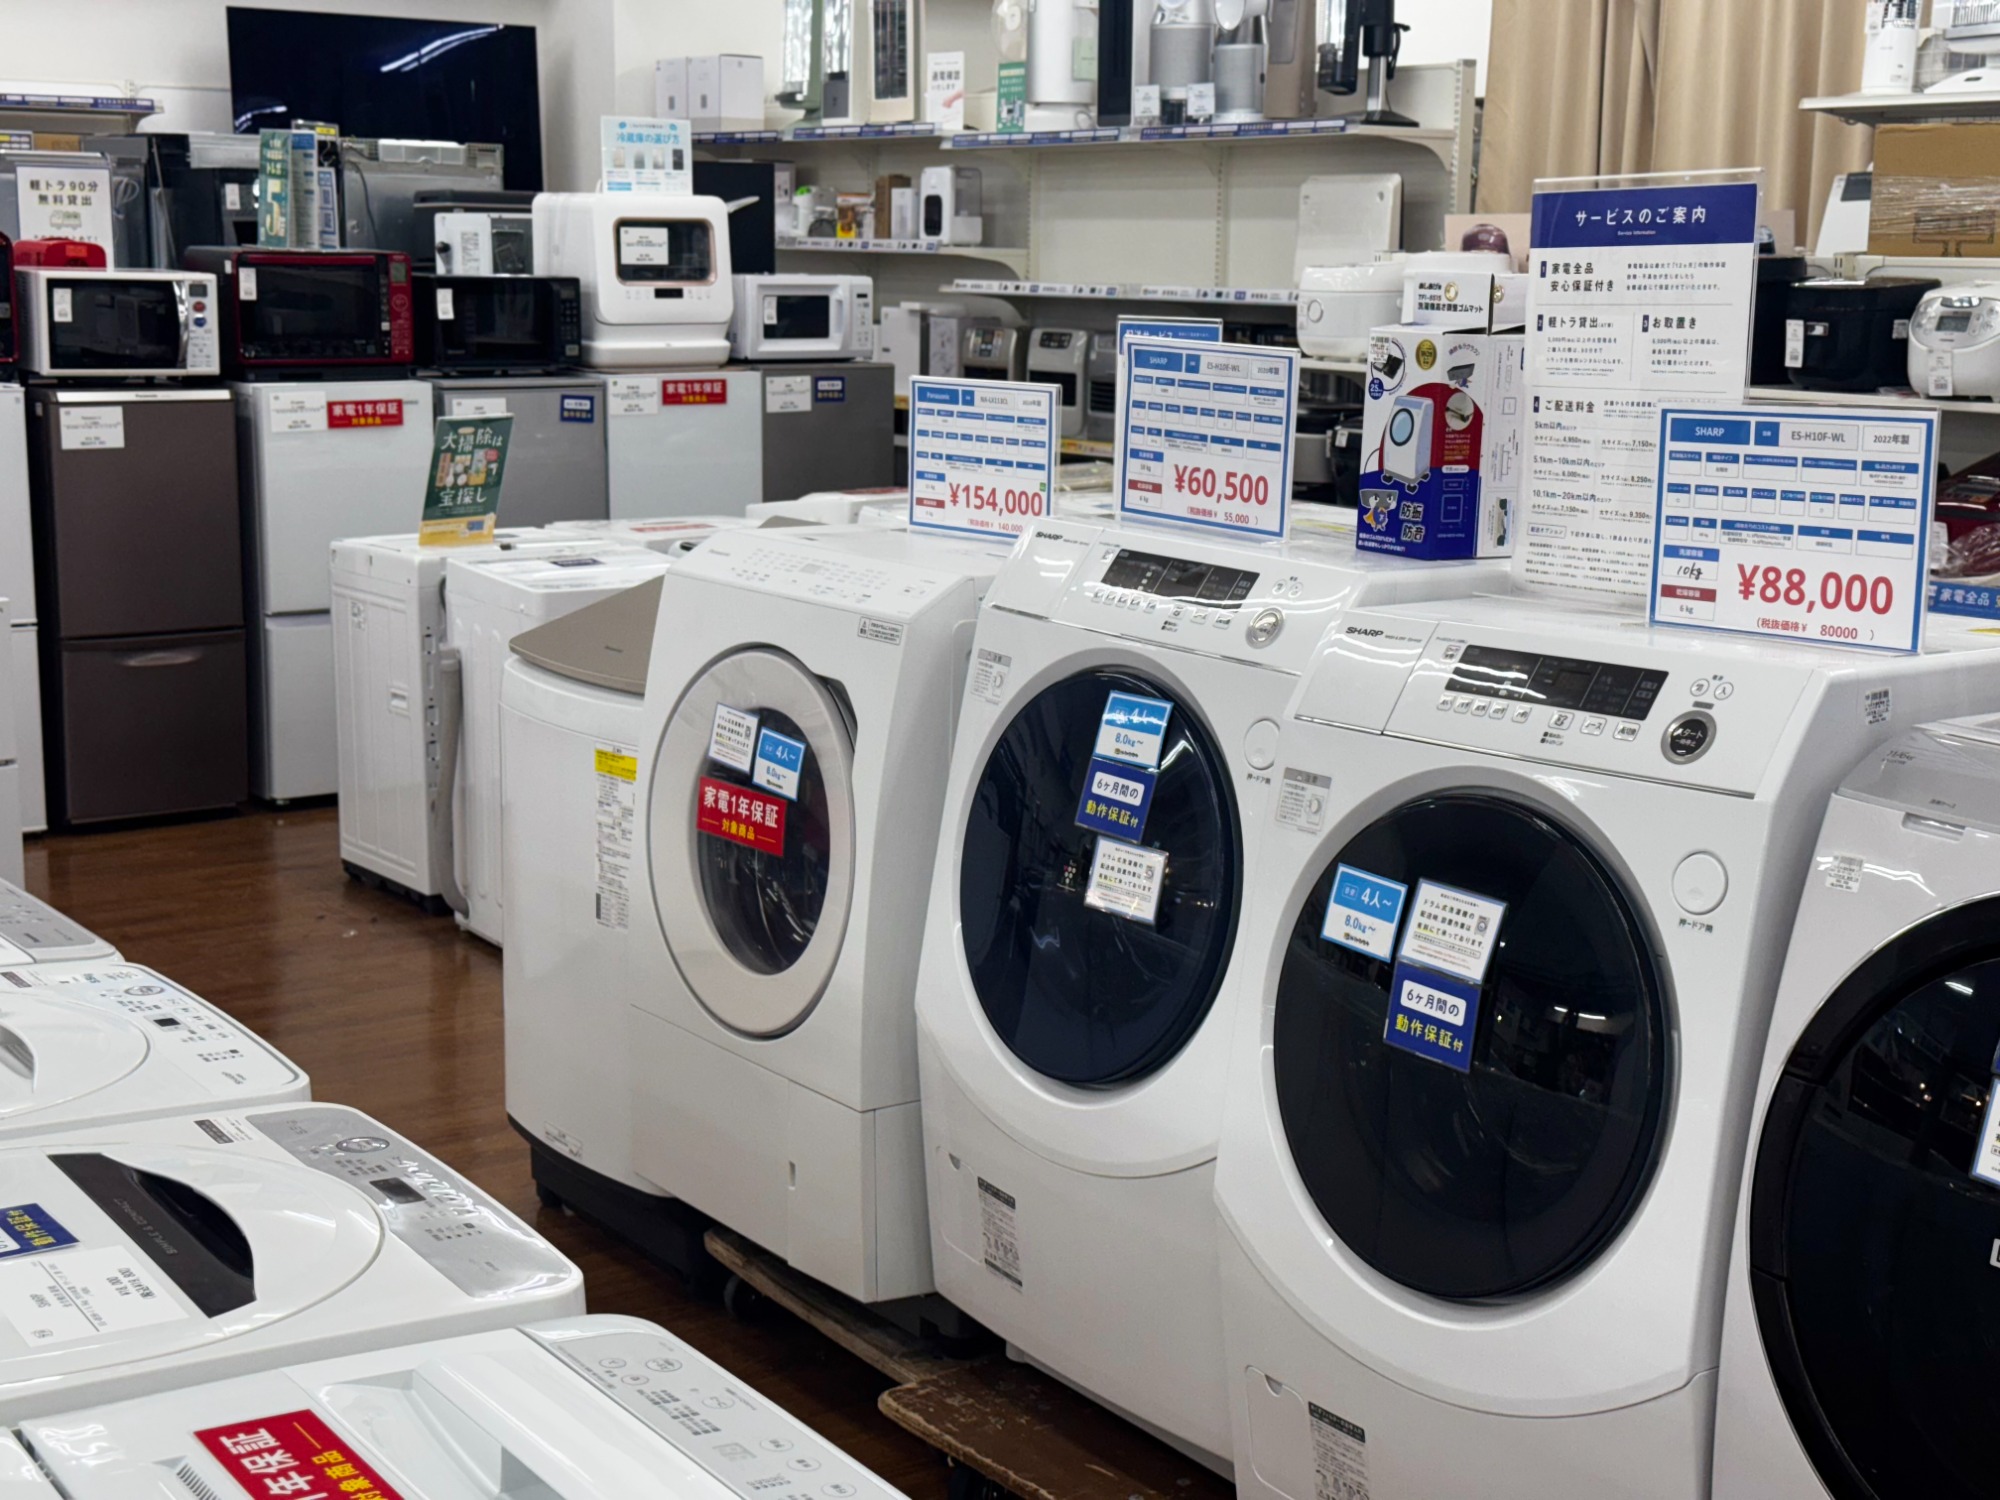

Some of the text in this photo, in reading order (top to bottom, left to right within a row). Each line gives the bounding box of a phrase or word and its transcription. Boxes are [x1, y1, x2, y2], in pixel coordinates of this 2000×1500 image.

[29, 179, 98, 192] 軽トラ90分
[38, 193, 93, 206] 無料貸出
[1575, 205, 1707, 227] サービスのご案内
[1551, 262, 1594, 275] 家電全品
[1550, 279, 1614, 292] 安心保証付き
[1548, 316, 1598, 328] 軽トラ貸出
[1652, 316, 1696, 329] お取置き
[1149, 356, 1168, 366] SHARP
[665, 381, 723, 395] 家電1年保証
[331, 401, 399, 416] 家電1年保証
[1545, 399, 1595, 413] ご配送料金
[440, 426, 503, 453] 大掃除は
[1695, 426, 1725, 437] SHARP
[1791, 431, 1846, 443] ES-H10F-WL
[1873, 434, 1910, 445] 2022年製
[1174, 464, 1269, 506] ¥60,500
[438, 486, 487, 508] 宝探し
[949, 482, 1043, 517] ¥154,000
[1224, 508, 1250, 525] 55,000
[1400, 502, 1424, 521] 防振
[998, 522, 1024, 533] 140,000
[1035, 530, 1063, 541] SHARP
[1401, 523, 1425, 542] 防音
[1676, 562, 1703, 580] 10kg
[1737, 563, 1894, 615] ¥88,000
[1939, 587, 1990, 606] 家電全品
[1345, 626, 1384, 638] SHARP
[1820, 624, 1858, 640] 80000
[1096, 778, 1139, 800] 6ヶ月間の
[703, 785, 779, 829] 家電1年保証
[1085, 799, 1139, 829] 動作保証付
[721, 817, 755, 841] 対象商品
[1406, 988, 1460, 1018] 6ヶ月間の
[1394, 1013, 1464, 1053] 動作保証付
[6, 1209, 57, 1247] 動作保証付
